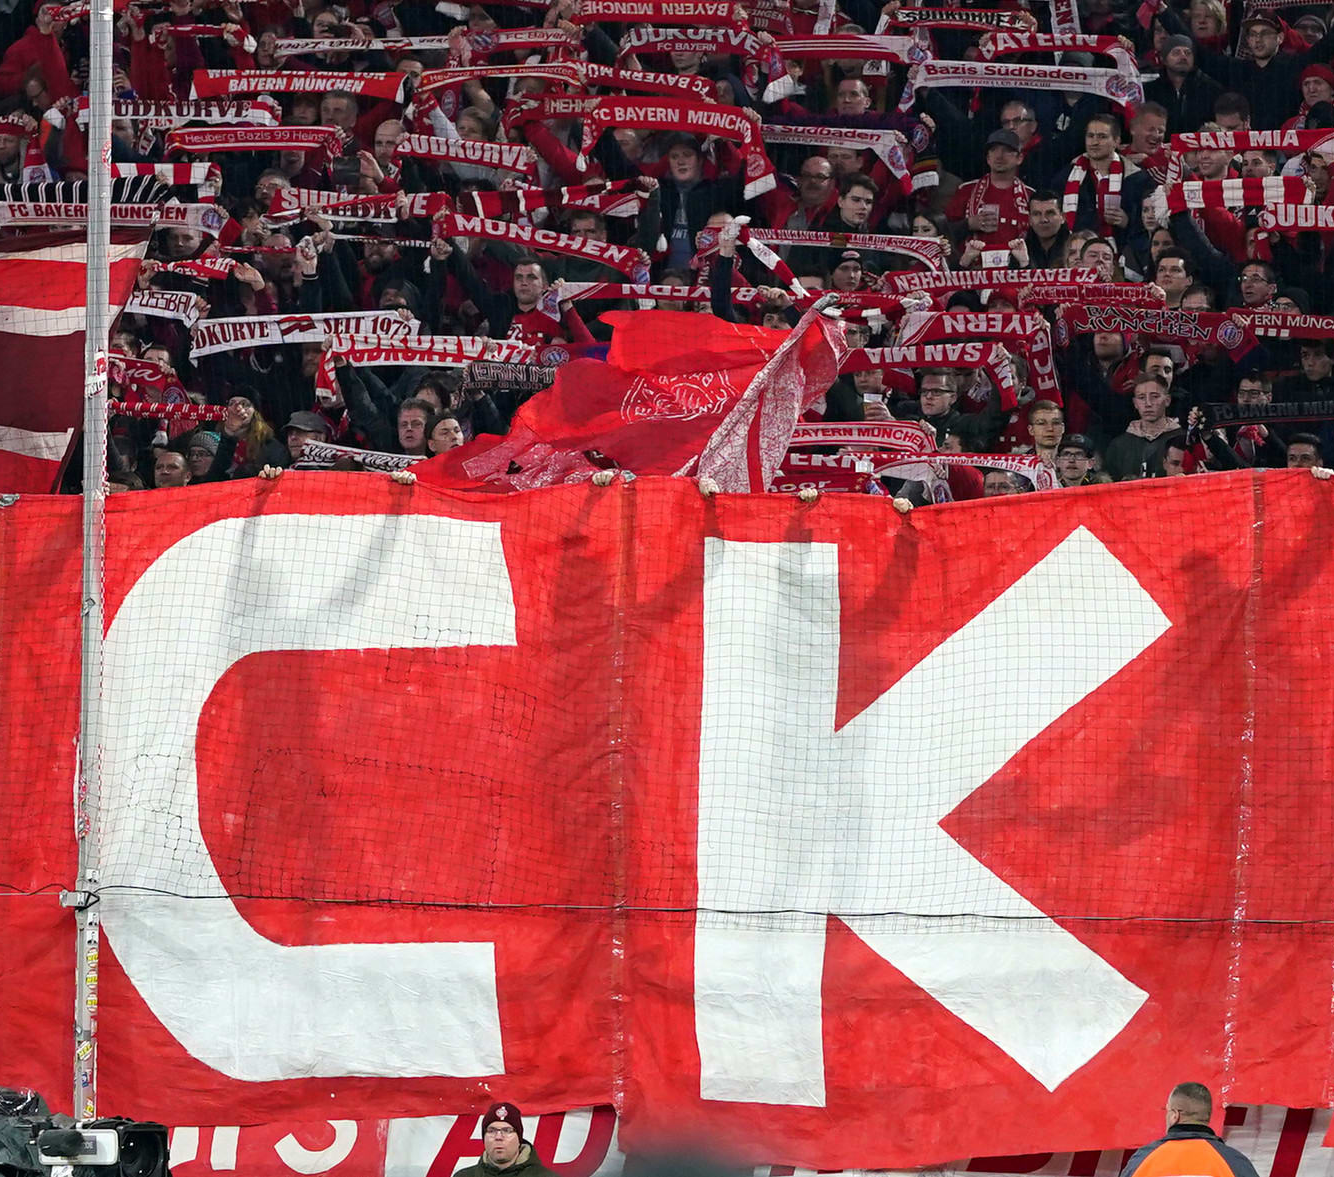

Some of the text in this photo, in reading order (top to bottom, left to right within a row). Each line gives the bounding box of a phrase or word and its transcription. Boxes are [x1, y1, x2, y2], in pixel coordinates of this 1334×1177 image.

[925, 62, 1087, 82] Bazis Südbaden
[614, 106, 680, 123] BAYERN
[1180, 130, 1298, 148] SAN MIA
[8, 204, 30, 218] FC
[33, 204, 87, 218] BAYER
